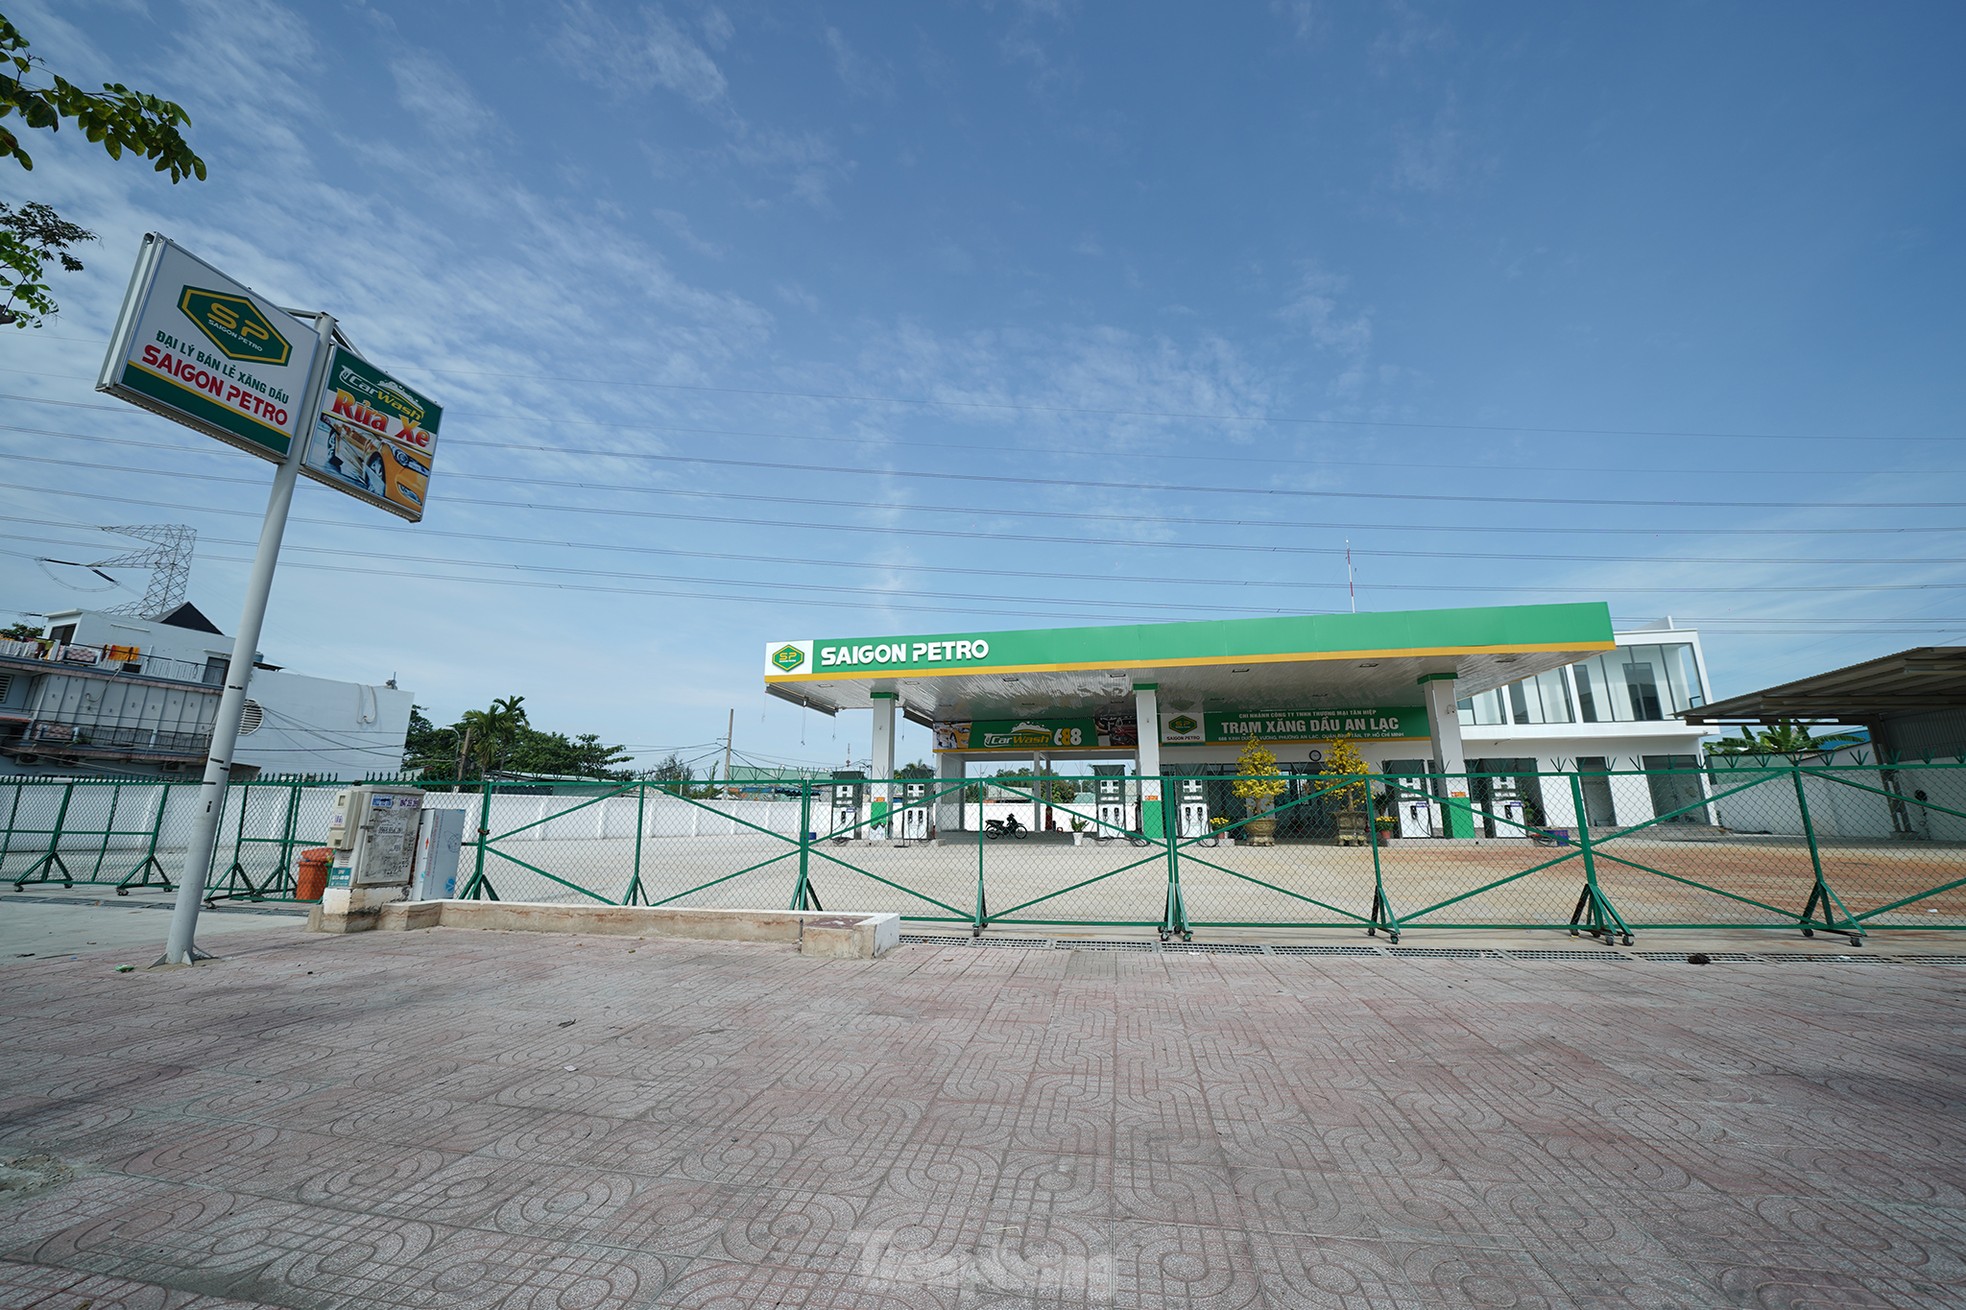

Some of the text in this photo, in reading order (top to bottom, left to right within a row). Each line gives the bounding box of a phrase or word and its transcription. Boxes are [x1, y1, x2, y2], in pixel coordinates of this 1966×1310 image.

[207, 302, 270, 341] SP
[207, 319, 264, 352] SAIGON PETRO
[142, 344, 288, 426] SAIGON PETRO
[156, 330, 289, 404] ĐẠI LÝ BÁN LẺ XĂNG DẦU
[331, 387, 430, 448] Rửa Xe
[820, 639, 990, 667] SAIGON PETRO
[1053, 728, 1082, 746] 688
[1221, 716, 1399, 735] TRẠM XĂNG DẦU AN LẠC
